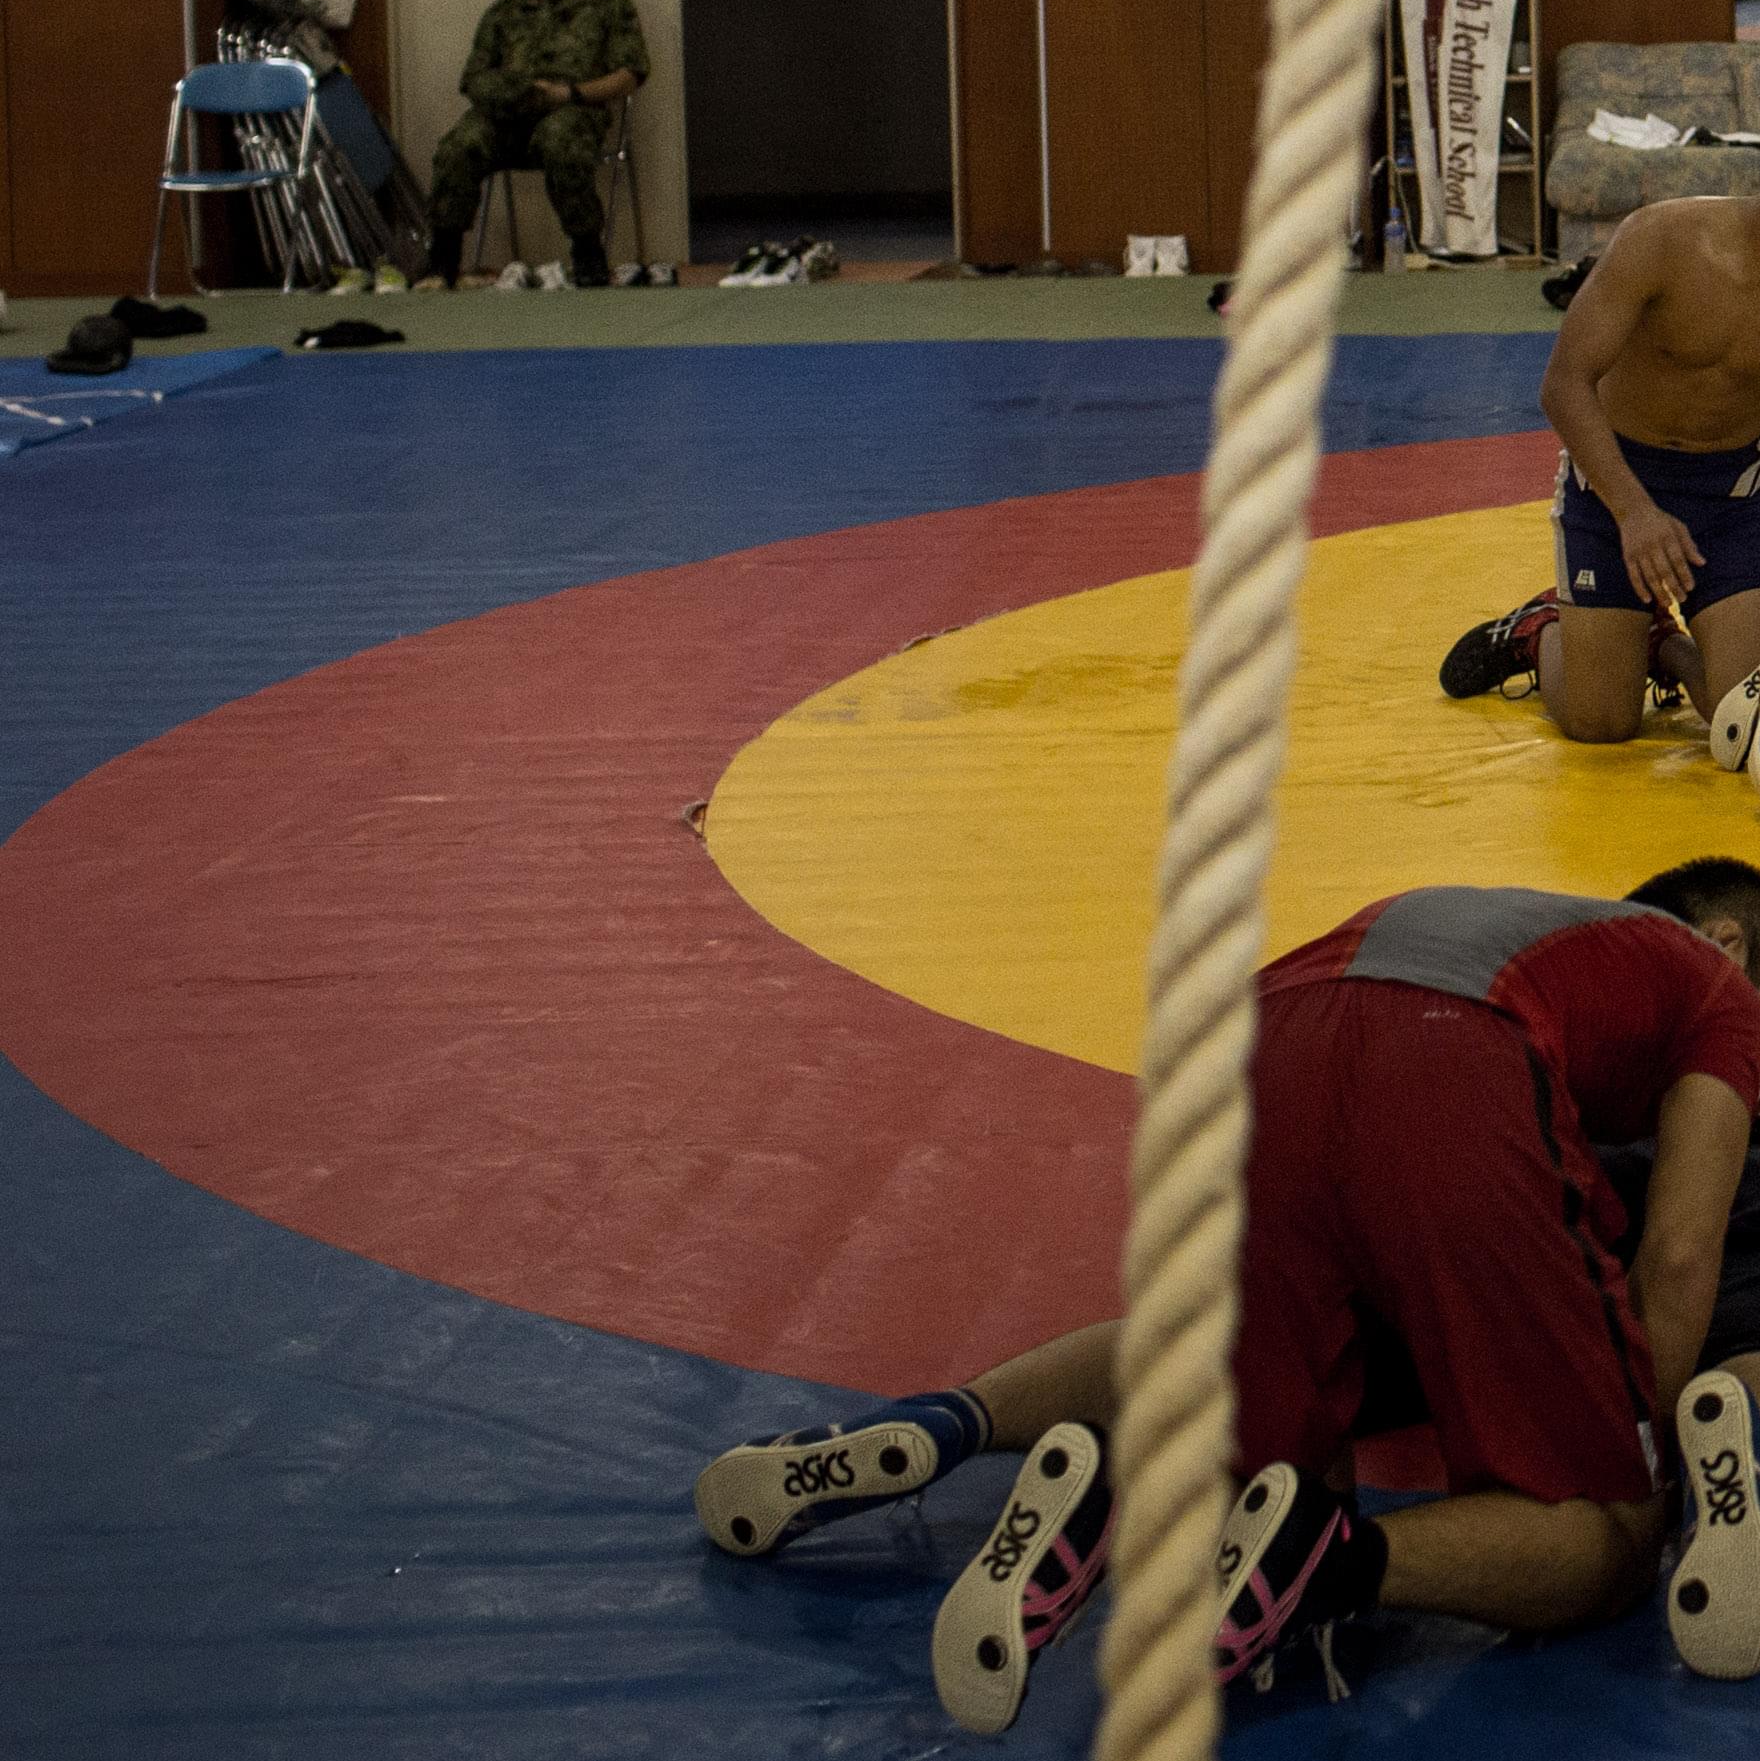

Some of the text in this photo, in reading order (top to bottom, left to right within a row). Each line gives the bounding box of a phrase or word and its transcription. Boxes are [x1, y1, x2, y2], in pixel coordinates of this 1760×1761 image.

[1440, 16, 1490, 134] Technical
[1443, 136, 1478, 222] School
[784, 1449, 855, 1498] asics
[1700, 1449, 1747, 1526] asics
[982, 1500, 1041, 1583] asics
